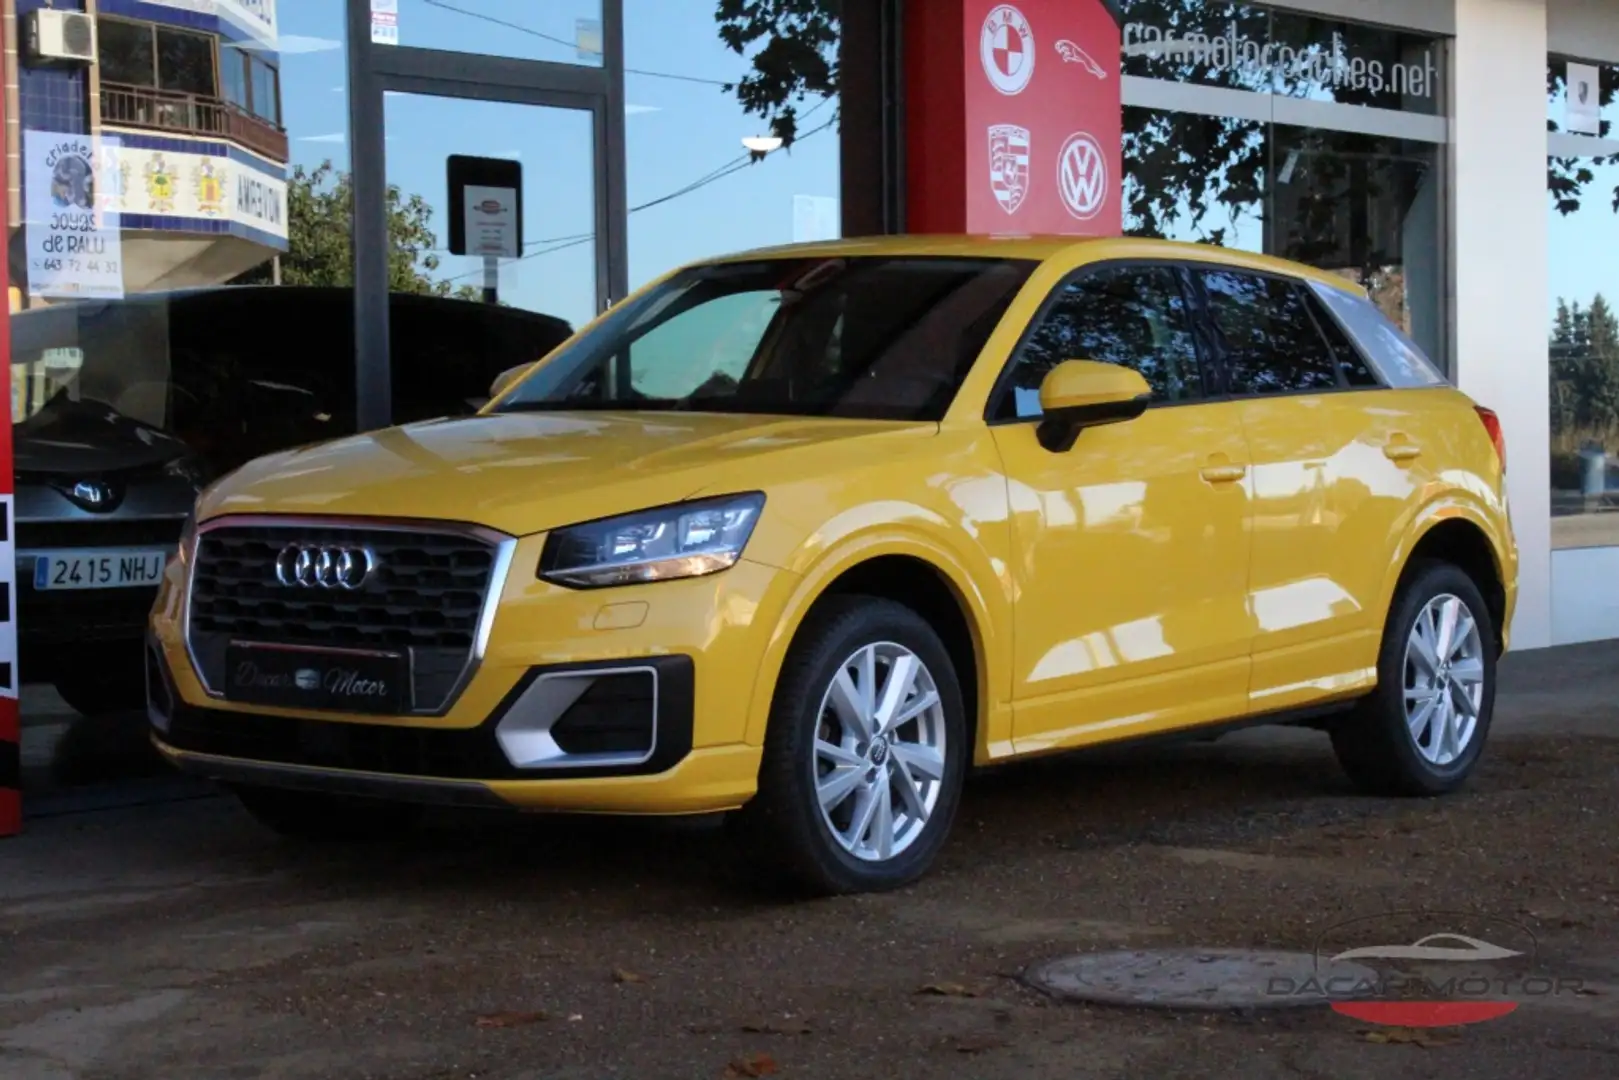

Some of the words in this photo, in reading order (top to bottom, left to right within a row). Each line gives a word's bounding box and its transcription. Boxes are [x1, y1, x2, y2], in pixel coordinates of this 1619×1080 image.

[42, 235, 63, 253] de
[44, 258, 62, 271] 643
[53, 558, 112, 584] 2415
[119, 556, 159, 582] NHJ
[323, 665, 389, 697] Motor
